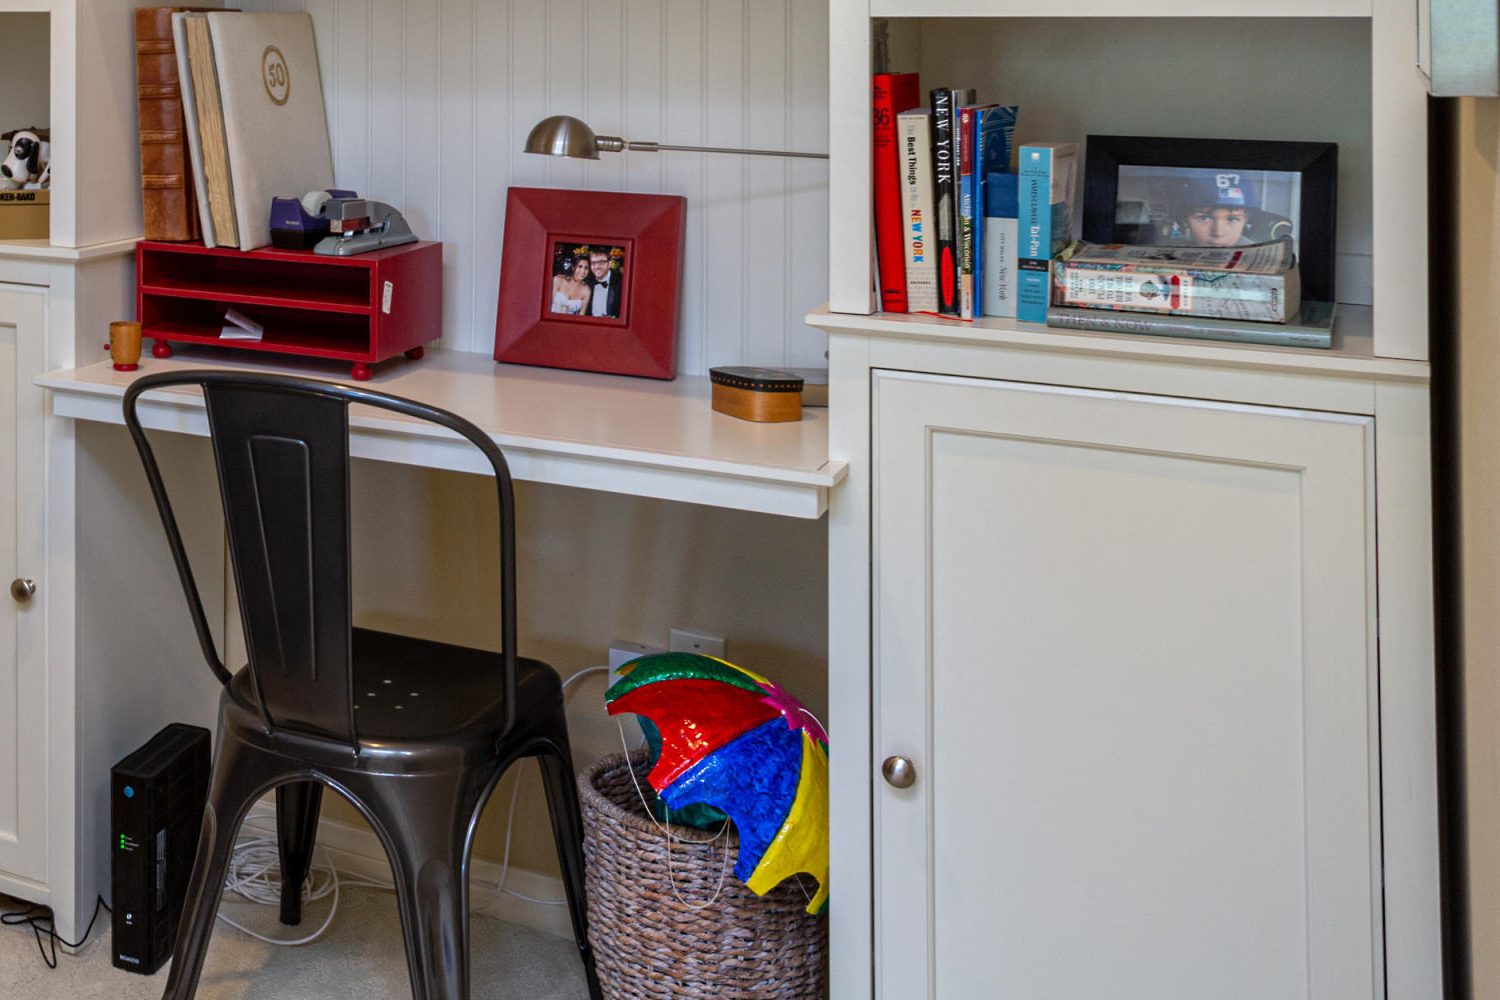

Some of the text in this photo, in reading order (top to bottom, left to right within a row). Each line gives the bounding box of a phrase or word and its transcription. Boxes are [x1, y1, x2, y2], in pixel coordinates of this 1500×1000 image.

[267, 64, 286, 88] 50
[907, 136, 916, 156] Best
[935, 95, 952, 184] NEW YORK
[907, 156, 918, 186] Things
[910, 209, 923, 233] NEW
[912, 234, 925, 263] YORK
[963, 232, 972, 269] Wisconsin
[1029, 224, 1041, 257] Tai-Pan
